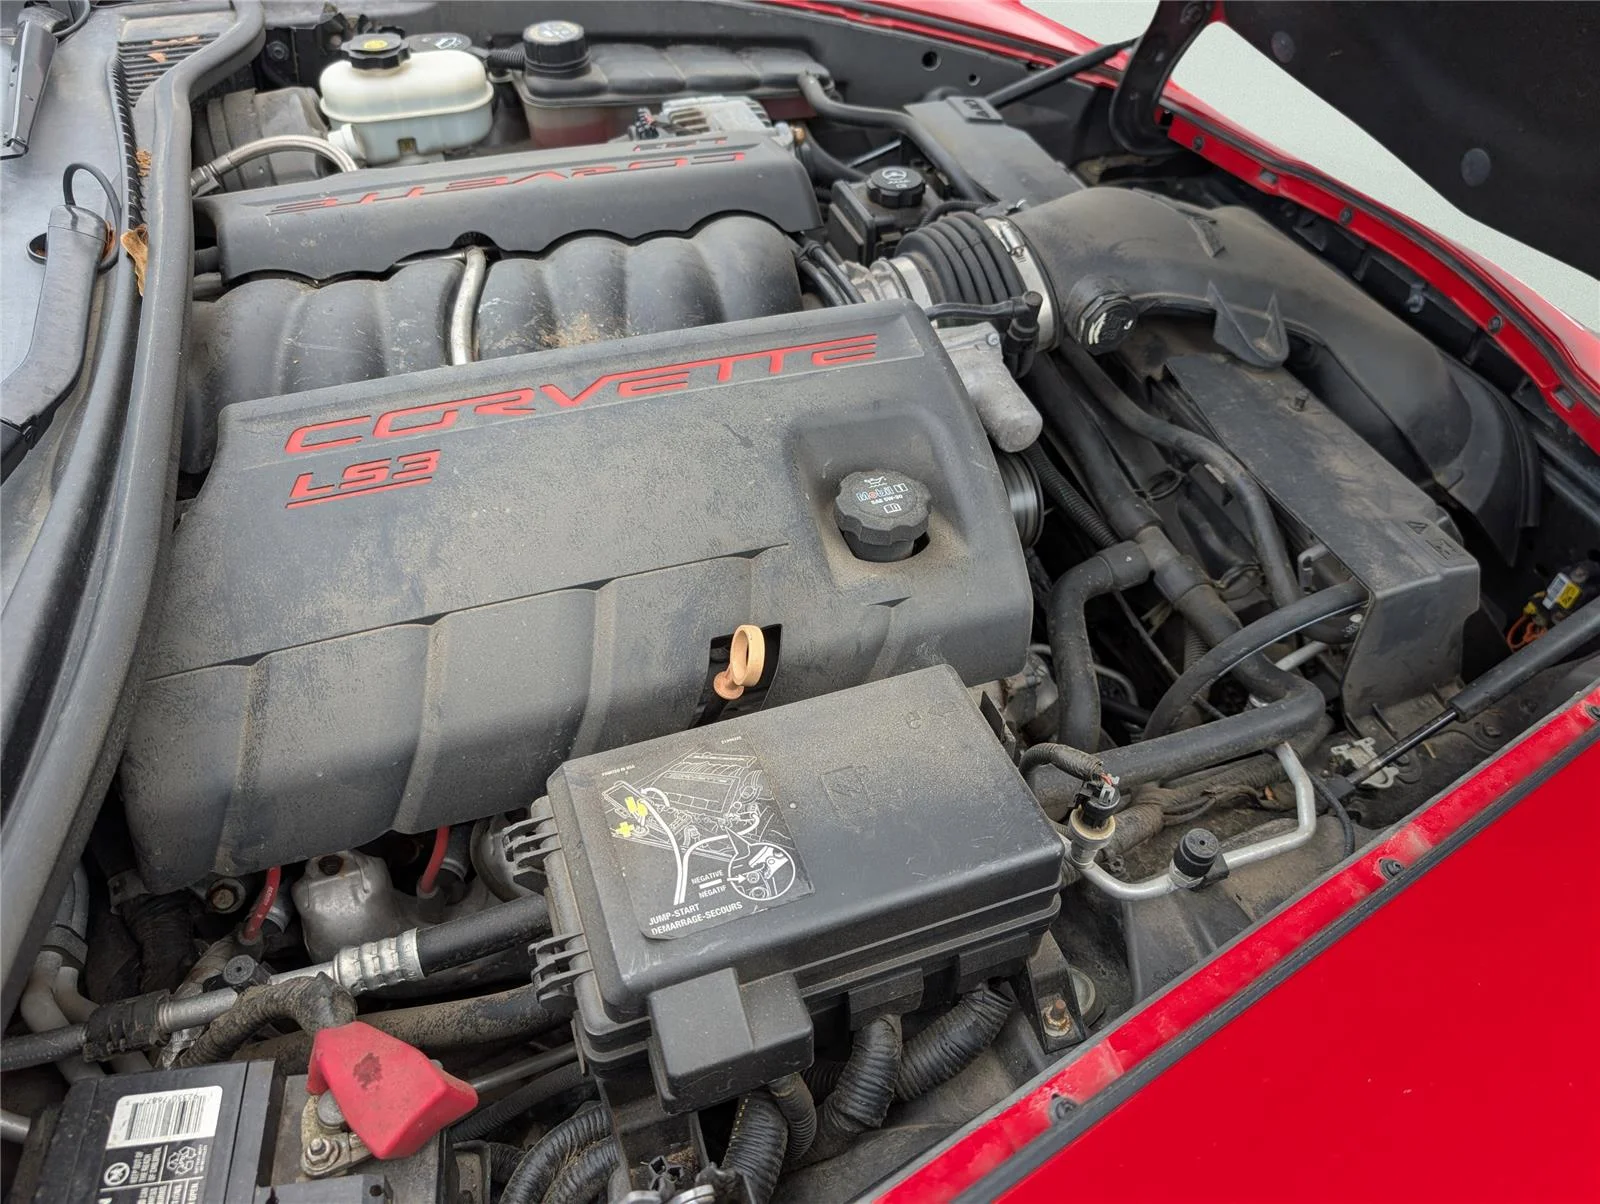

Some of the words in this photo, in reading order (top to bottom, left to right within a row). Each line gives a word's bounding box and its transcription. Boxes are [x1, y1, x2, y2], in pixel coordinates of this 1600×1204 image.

[266, 152, 745, 215] CORVETTE
[284, 333, 877, 455] CORVETTE
[287, 448, 441, 500] LS3
[856, 484, 894, 502] Mobil
[691, 869, 725, 885] NEGATIVE
[698, 884, 727, 899] NEGATIF
[649, 903, 700, 926] JUMP-START
[651, 901, 743, 936] DEMARRAGE-SECOURS
